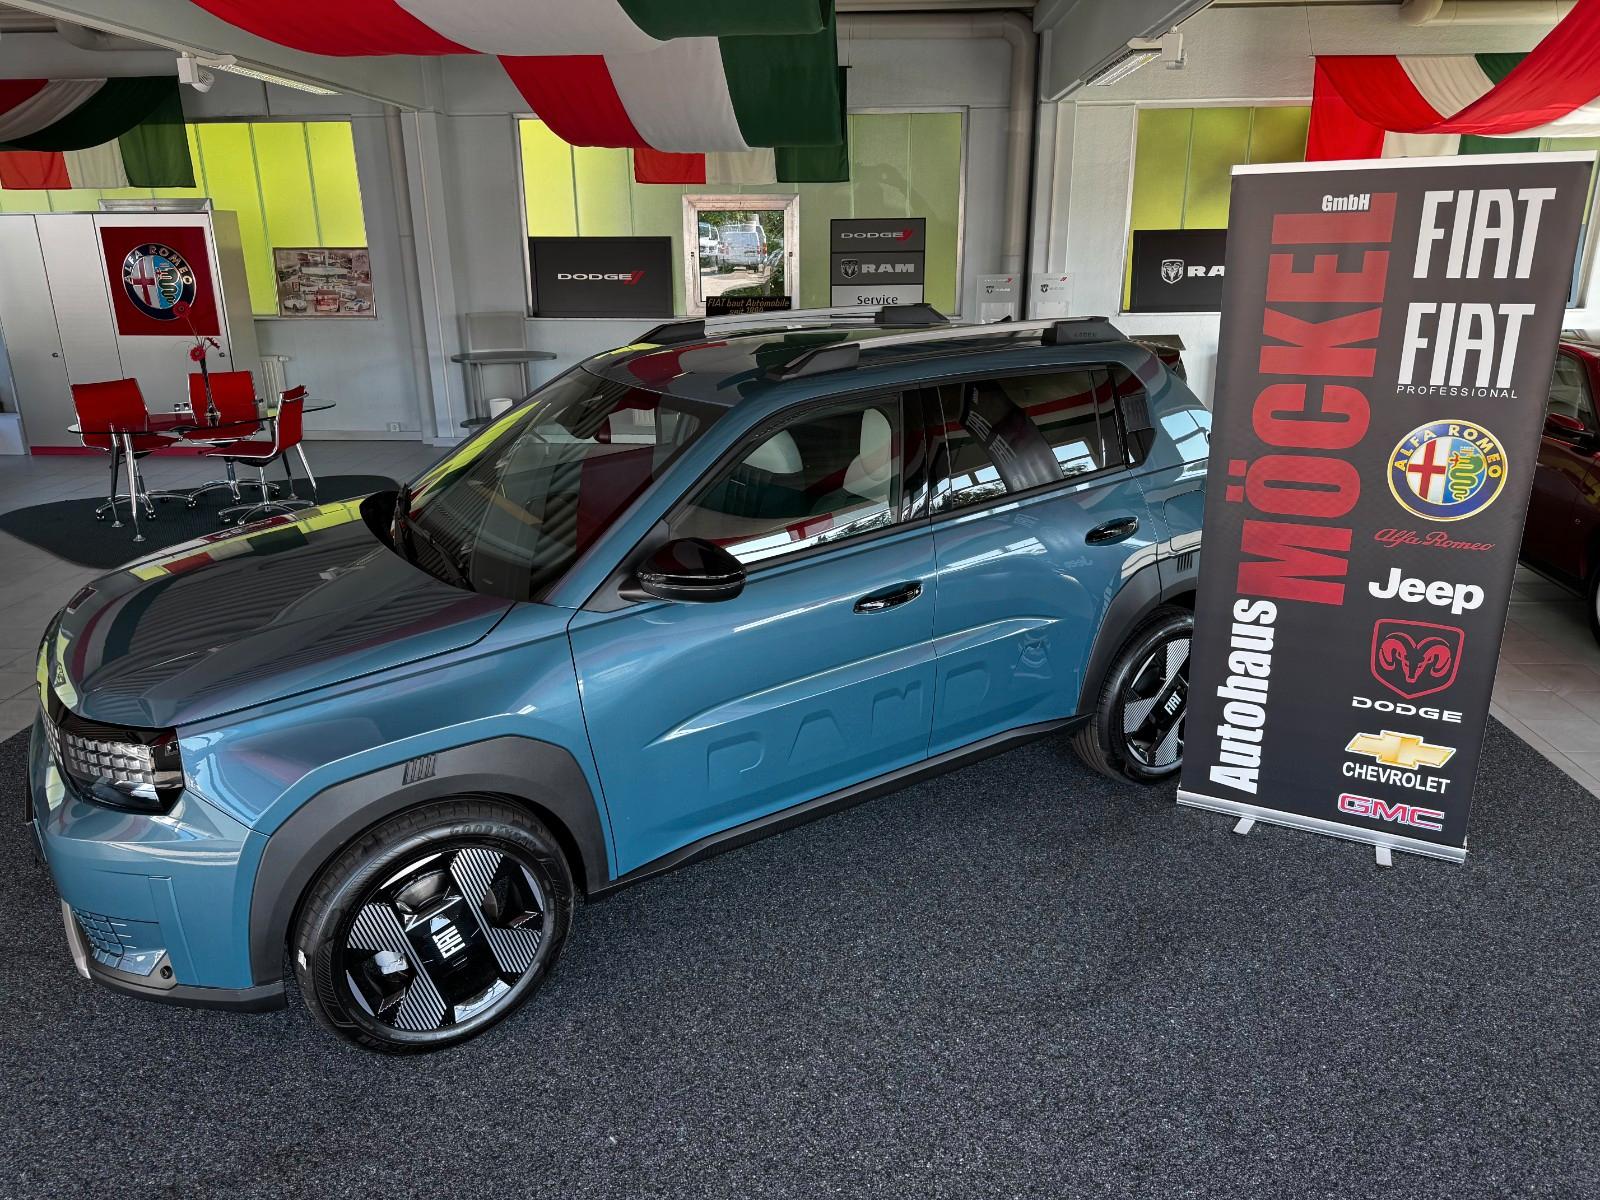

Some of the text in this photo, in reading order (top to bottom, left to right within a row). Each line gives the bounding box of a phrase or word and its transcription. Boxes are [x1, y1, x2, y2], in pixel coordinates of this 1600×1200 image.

[1321, 192, 1370, 213] GmbH
[840, 231, 904, 239] DODGE
[1413, 187, 1557, 279] FIAT
[124, 245, 193, 285] ALFA ROMEO
[557, 273, 633, 281] DODGE
[861, 263, 915, 273] RAM
[1187, 265, 1225, 277] RA
[707, 297, 790, 307] FIAT baut Automobile
[857, 294, 899, 305] Service
[1397, 302, 1536, 389] FIAT
[1396, 384, 1519, 399] PROFESSIONAL
[1393, 424, 1502, 479] ALFA ROMEO
[1209, 192, 1398, 795] Autohaus MÖCKEL
[1373, 528, 1496, 552] Alfa Romeo
[1368, 567, 1485, 615] Jeep
[1163, 690, 1182, 716] FIAT
[1352, 696, 1463, 724] DODGE
[1342, 761, 1451, 794] CHEVROLET
[1337, 793, 1446, 832] GMC
[432, 925, 466, 959] FIAT
